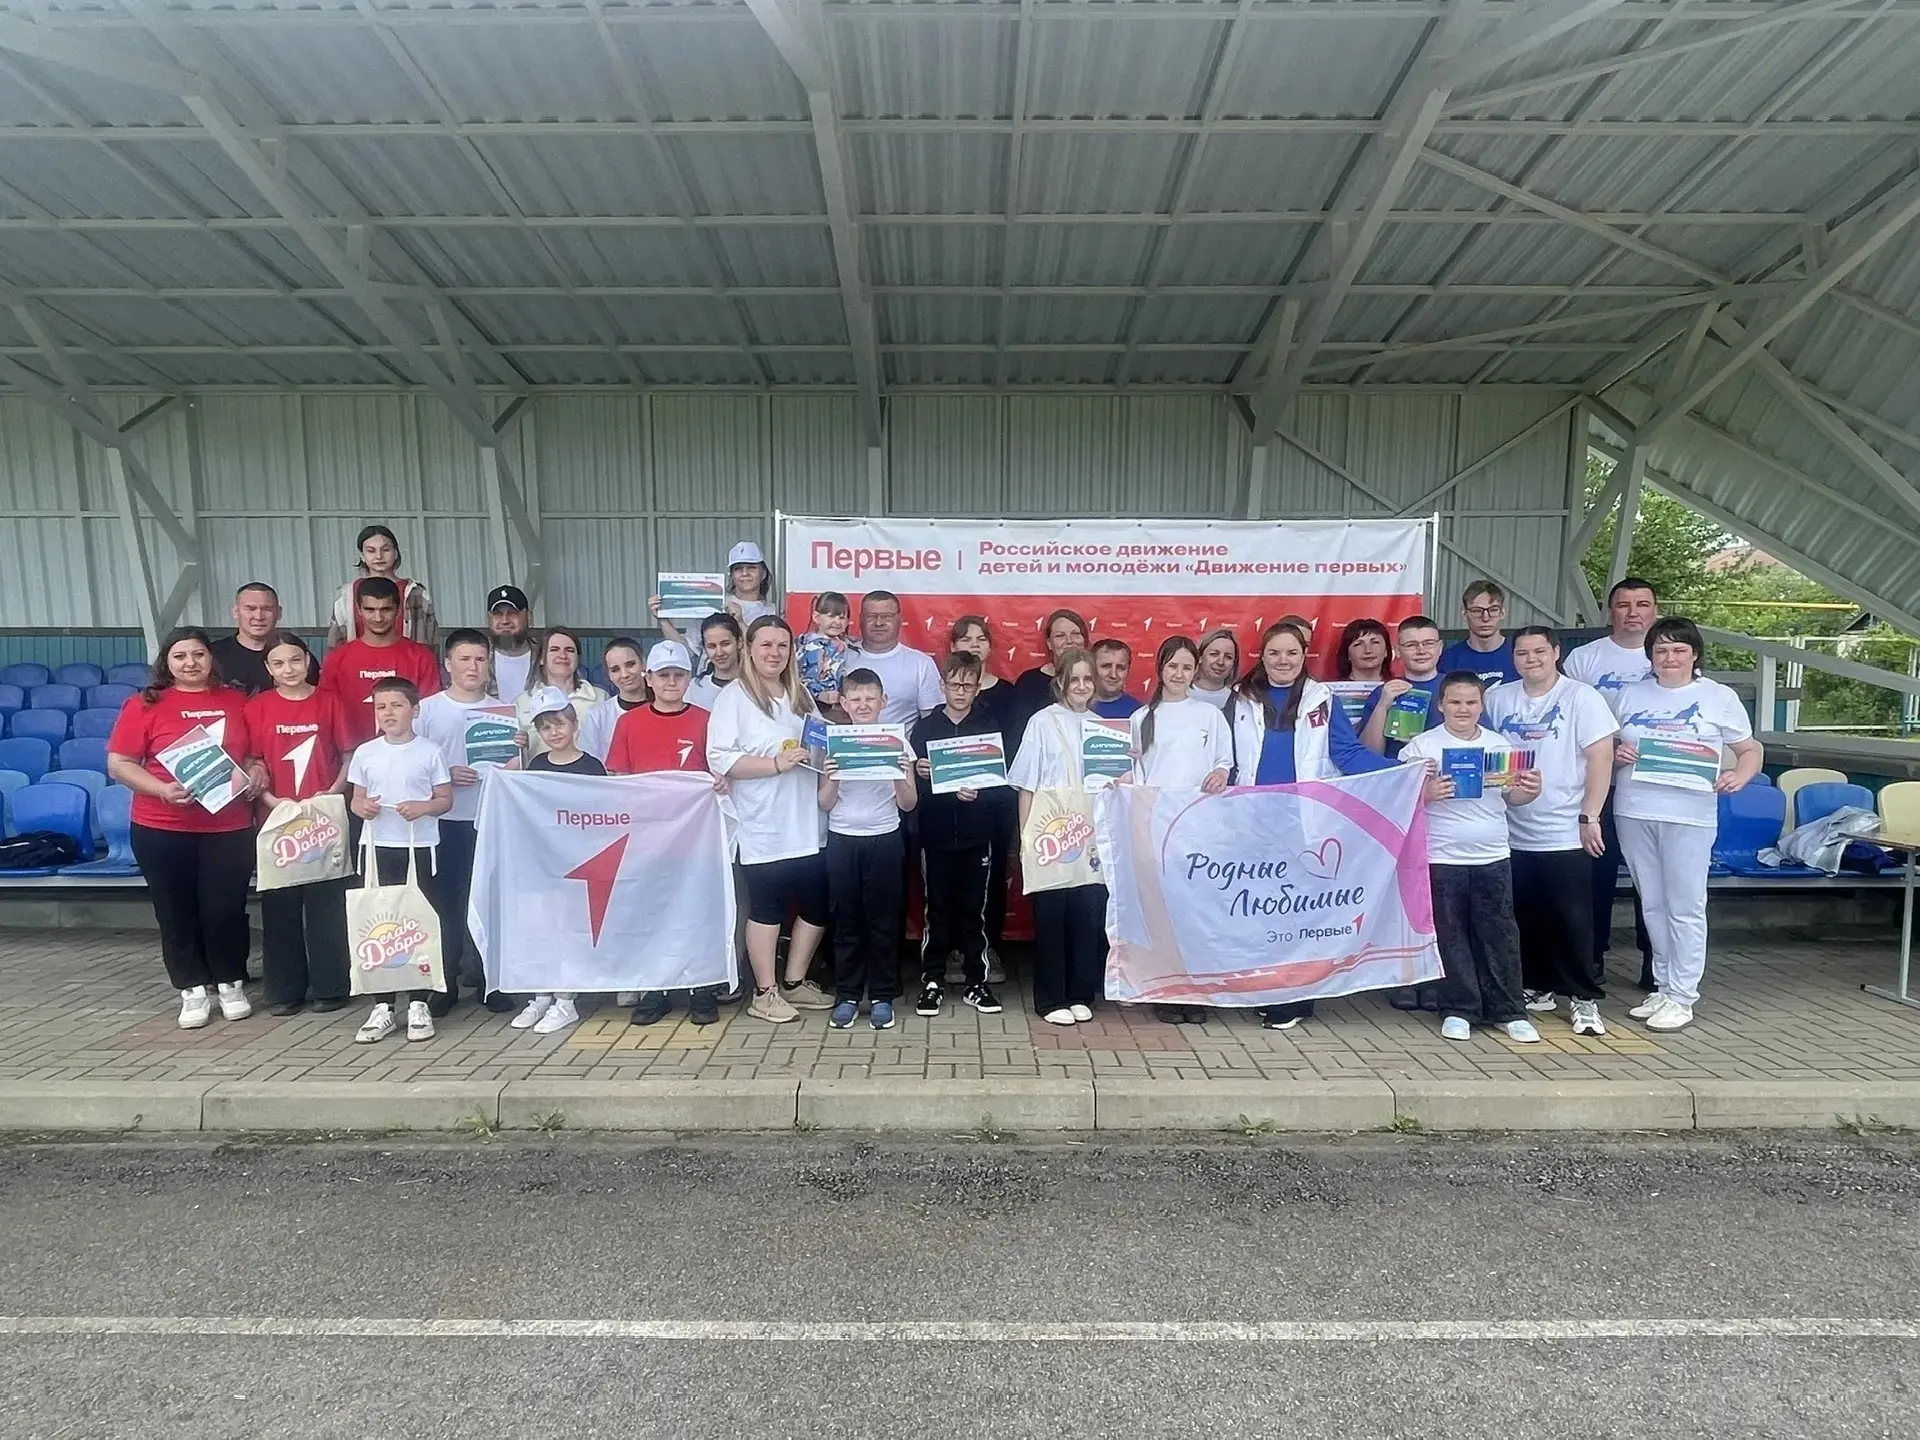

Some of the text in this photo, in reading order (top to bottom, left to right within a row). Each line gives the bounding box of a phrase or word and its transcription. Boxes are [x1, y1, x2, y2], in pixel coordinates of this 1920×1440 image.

[811, 541, 942, 578] Первые
[978, 541, 1229, 557] Российское движение
[978, 559, 1408, 577] детей и молодёжи «Движение первых»
[359, 670, 396, 681] Первые
[180, 709, 226, 720] Первые
[275, 723, 319, 736] Первые
[556, 809, 631, 830] Первые
[273, 826, 339, 867] Добро
[1034, 824, 1092, 866] Добро
[1186, 852, 1288, 891] Родные
[1229, 884, 1365, 917] Любимые
[1266, 925, 1352, 944] Это Первые
[358, 930, 427, 972] Добро
